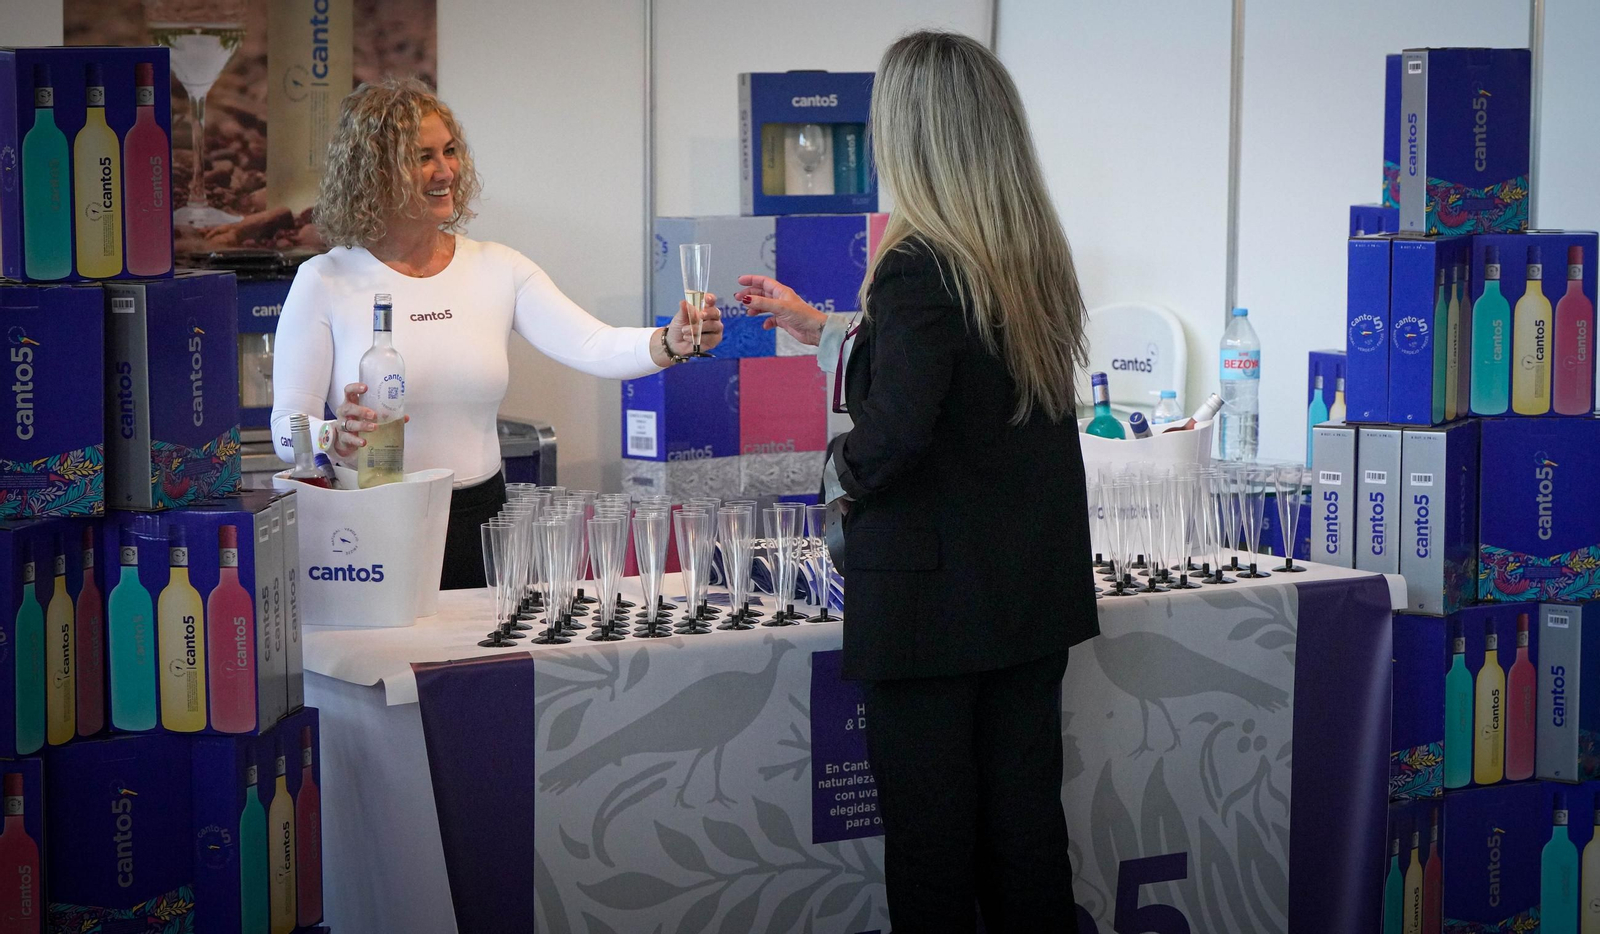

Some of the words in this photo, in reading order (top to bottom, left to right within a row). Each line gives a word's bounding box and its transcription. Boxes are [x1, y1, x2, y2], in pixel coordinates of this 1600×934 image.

[791, 94, 838, 108] canto5
[1407, 112, 1418, 177] canto5
[1473, 97, 1488, 173] canto5
[100, 156, 112, 209] canto5
[151, 156, 164, 208] canto5
[252, 304, 282, 318] cant
[410, 309, 453, 323] canto5
[1111, 355, 1153, 373] canto5
[1493, 319, 1503, 361] canto5
[1535, 319, 1545, 361] canto5
[1577, 319, 1587, 361] canto5
[11, 347, 35, 441] canto5
[116, 360, 134, 440] canto5
[189, 336, 204, 427] canto5
[280, 434, 293, 448] can
[668, 445, 713, 462] canto5
[1323, 490, 1339, 555] canto5
[1369, 491, 1385, 556] canto5
[1413, 493, 1430, 559] canto5
[1536, 466, 1553, 541] canto5
[308, 563, 385, 583] canto5
[262, 585, 271, 662] canto5
[289, 568, 298, 643] canto5
[62, 623, 70, 675] canto5
[183, 615, 196, 666] canto5
[234, 616, 247, 668] canto5
[1492, 688, 1500, 730] canto5
[1551, 665, 1566, 728] canto5
[845, 718, 855, 731] &
[825, 763, 840, 775] En
[842, 760, 871, 773] Cant
[830, 803, 876, 817] elegidas
[835, 791, 856, 802] con
[112, 797, 134, 888] canto5
[282, 820, 291, 871] canto5
[846, 817, 870, 830] para
[18, 865, 32, 917] canto5
[1487, 834, 1501, 908] canto5
